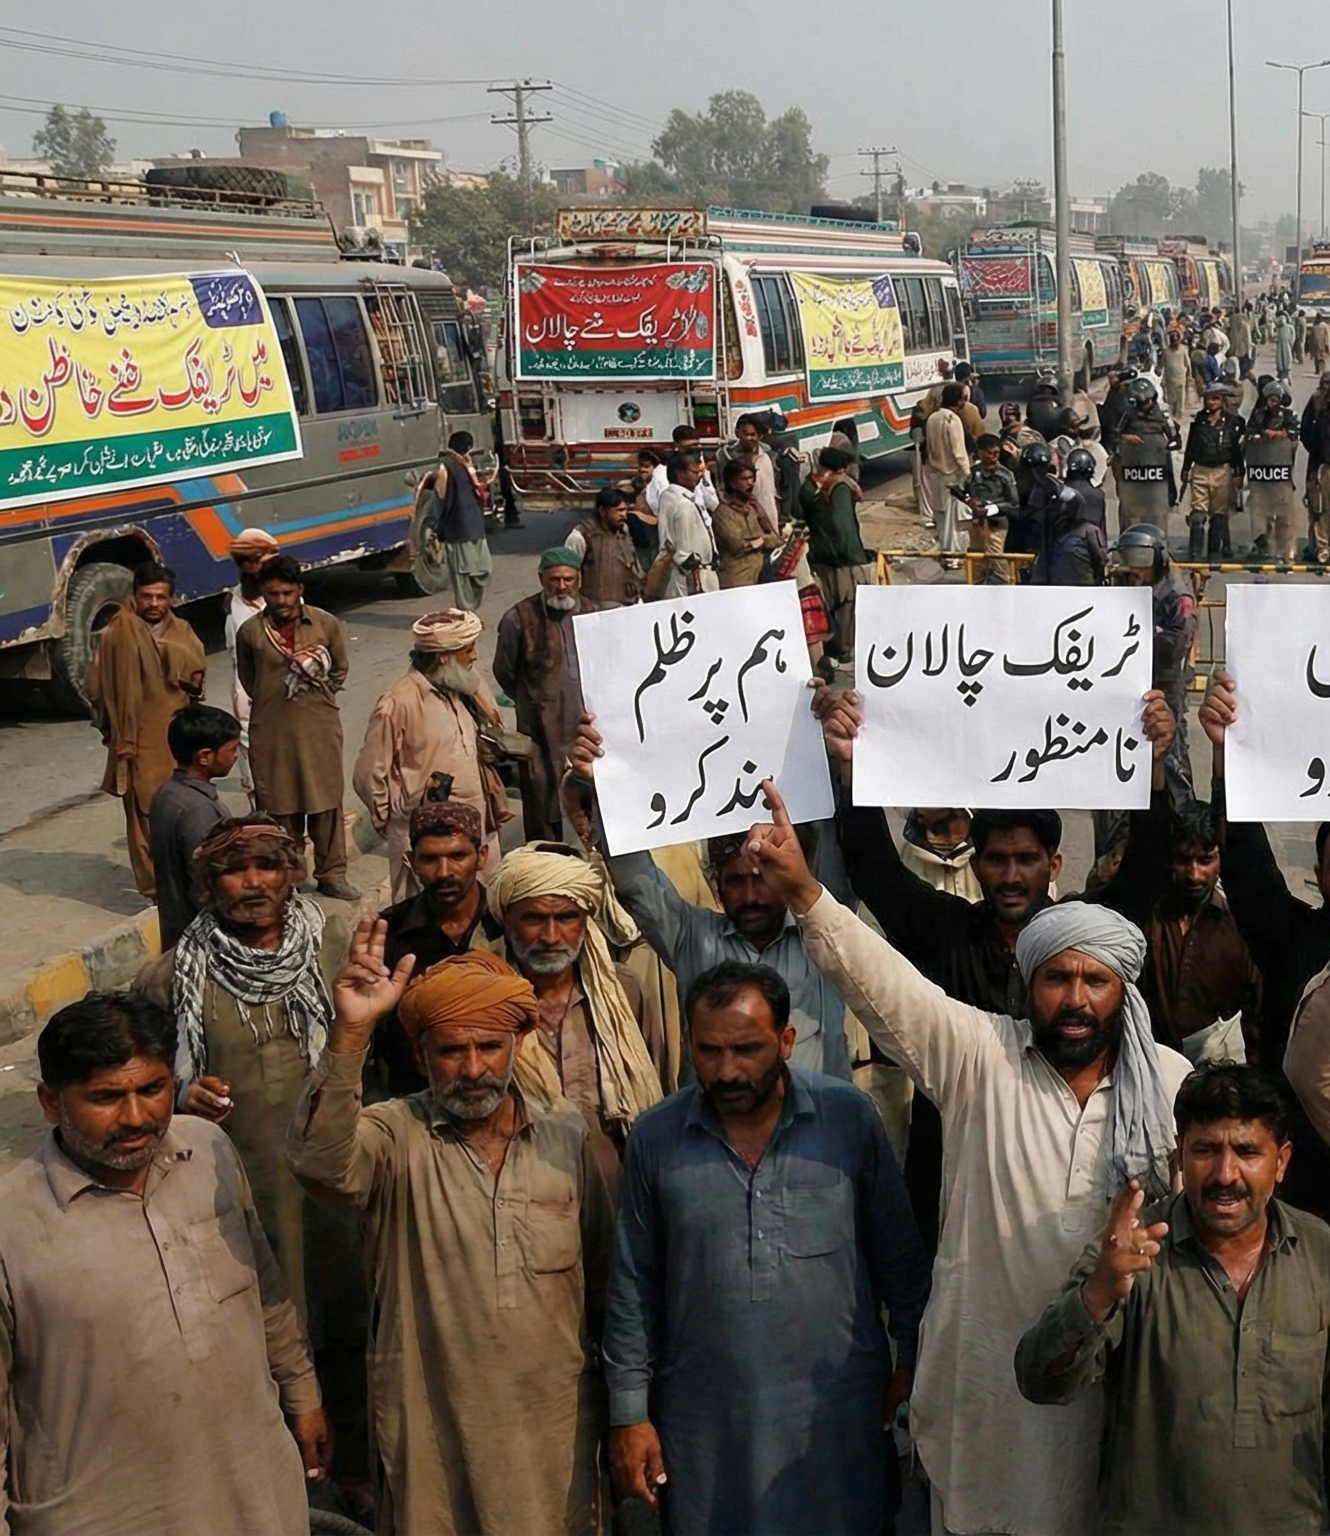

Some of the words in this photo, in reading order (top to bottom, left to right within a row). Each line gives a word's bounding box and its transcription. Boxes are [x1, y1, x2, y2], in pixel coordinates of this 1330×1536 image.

[525, 313, 580, 351] چالان
[1124, 467, 1164, 481] POLICE
[1250, 467, 1289, 480] POLICE
[634, 610, 697, 745] ظلم
[737, 628, 788, 724] ہم
[866, 623, 995, 707] چالان
[1003, 606, 1141, 692] ٹریفک
[687, 656, 730, 726] پر
[645, 735, 730, 830] کرو
[990, 713, 1140, 783] نامنظور
